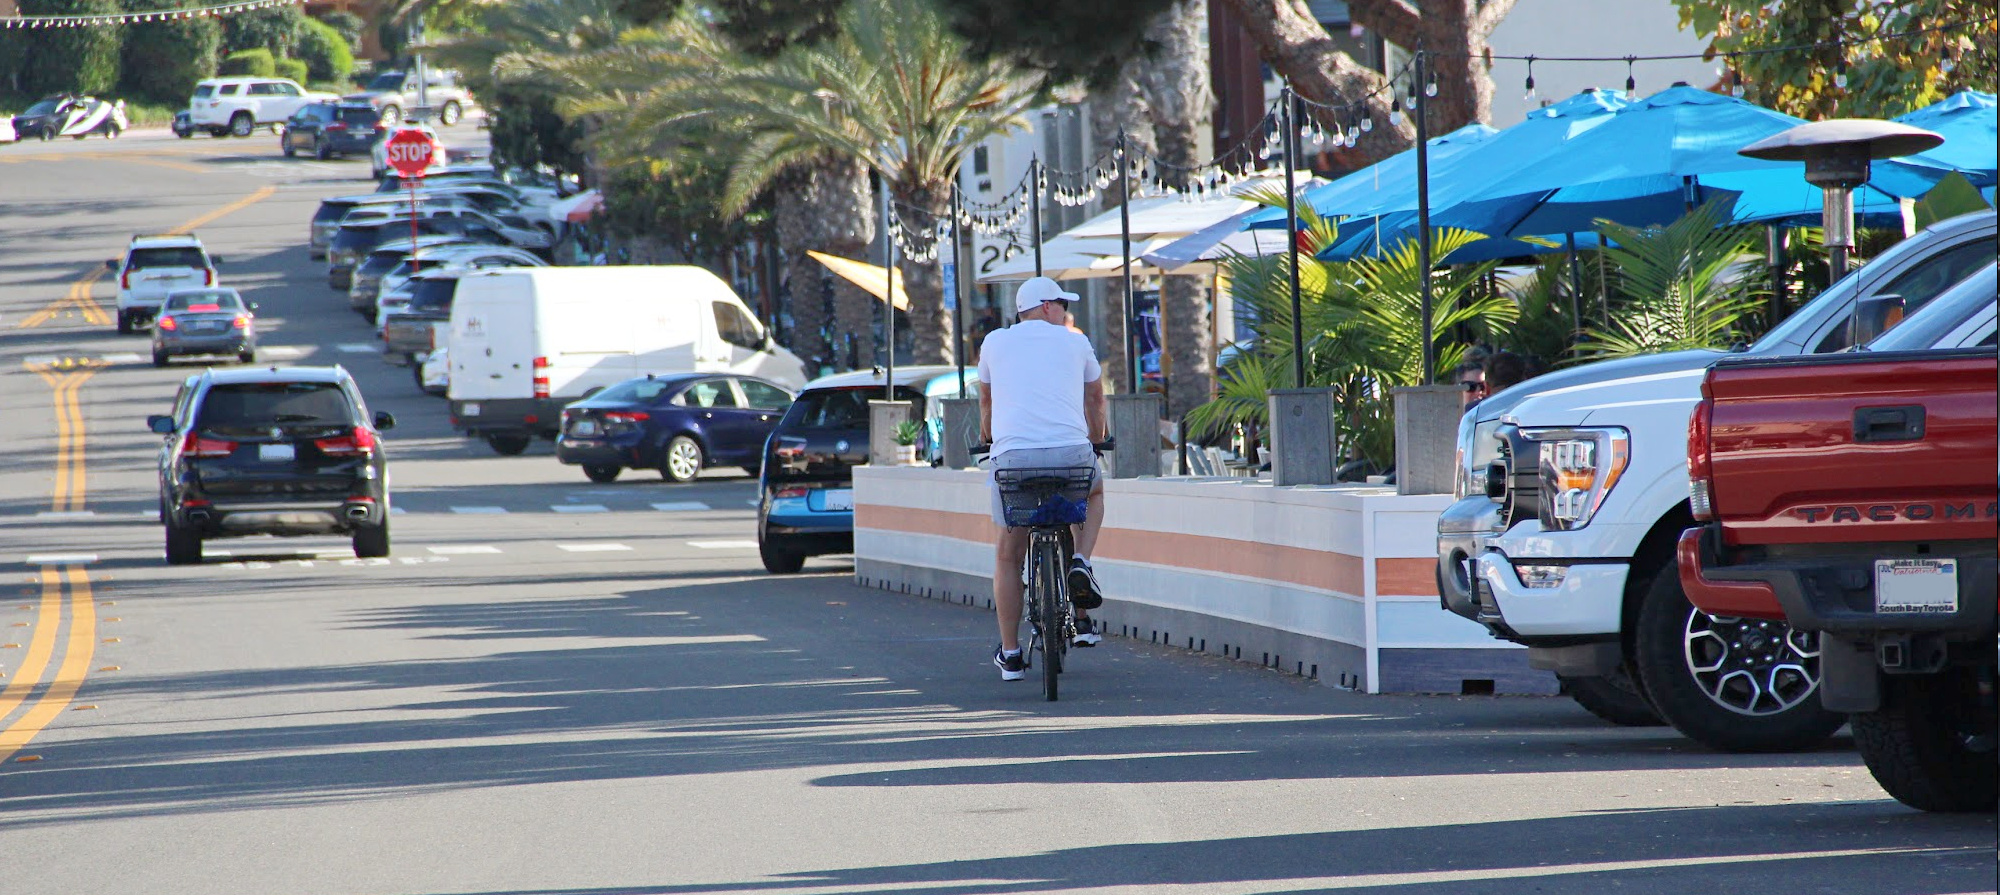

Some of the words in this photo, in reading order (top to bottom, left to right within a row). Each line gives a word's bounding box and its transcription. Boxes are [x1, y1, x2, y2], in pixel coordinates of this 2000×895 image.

[391, 142, 431, 162] STOP
[1922, 560, 1938, 568] Easy
[1879, 604, 1905, 613] South
[1906, 604, 1923, 614] Bay
[1923, 604, 1954, 614] Toyota
